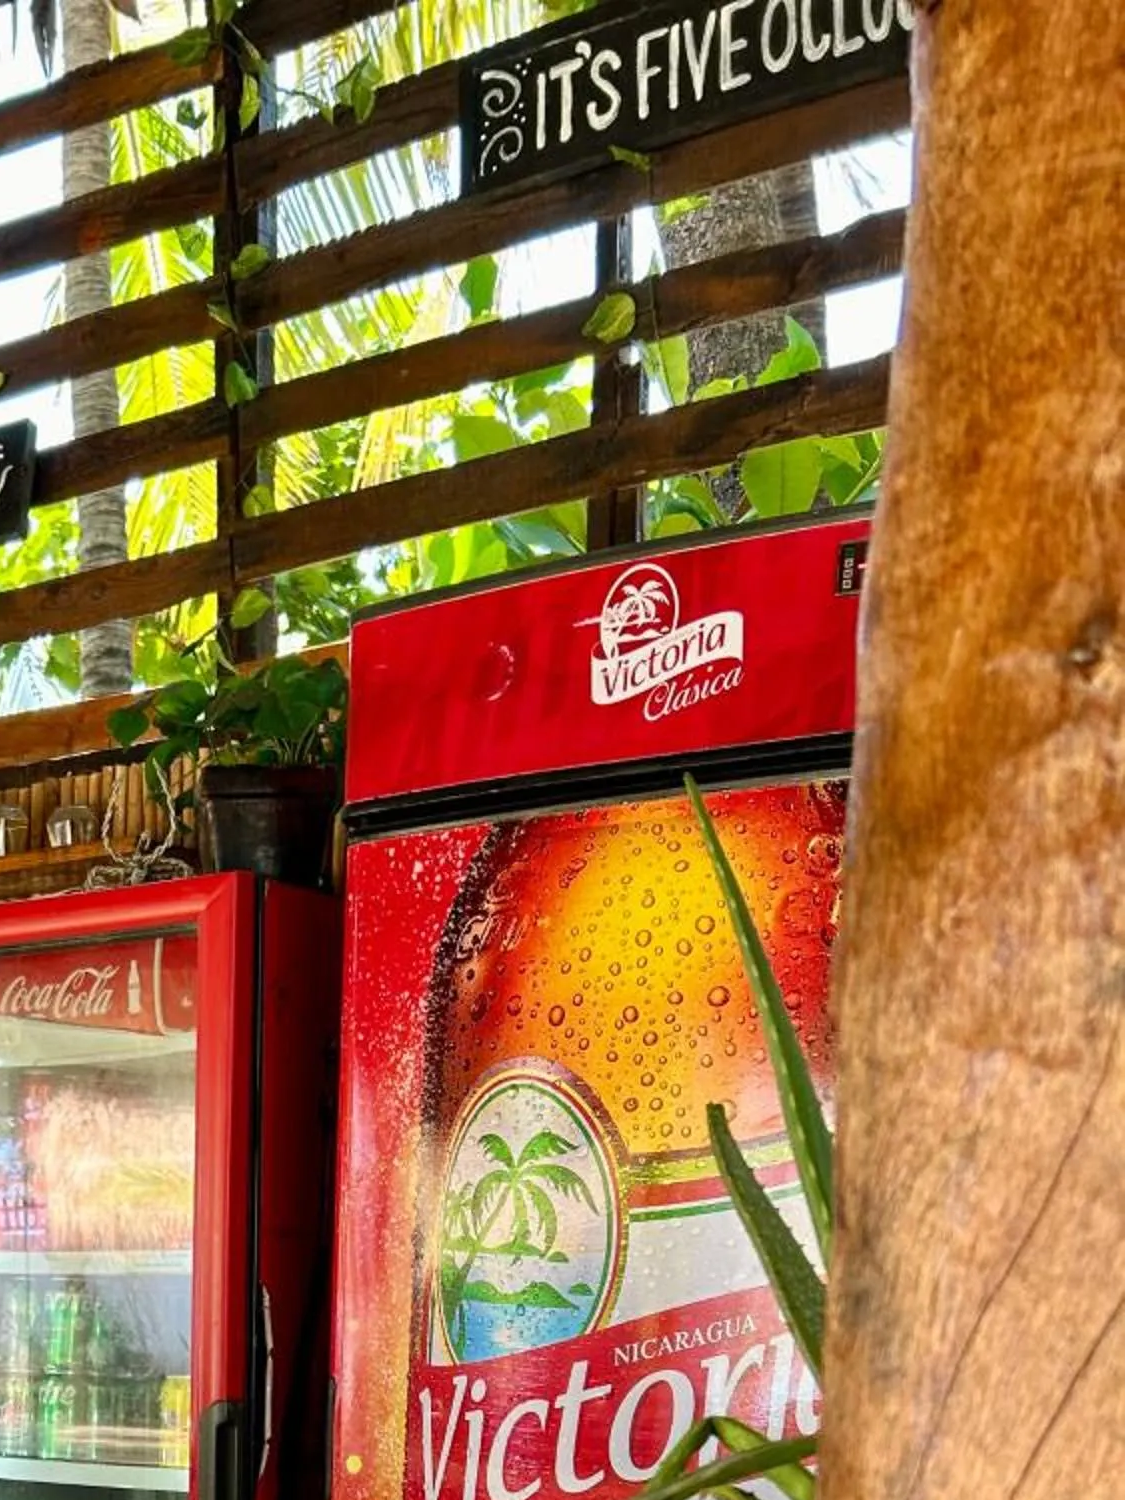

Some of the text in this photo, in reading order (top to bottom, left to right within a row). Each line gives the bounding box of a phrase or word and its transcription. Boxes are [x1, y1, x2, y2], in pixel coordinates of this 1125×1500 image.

[536, 39, 622, 151] IT'S
[637, 0, 753, 119] FIVE
[600, 621, 726, 698] Victoria
[643, 664, 745, 722] Clásica
[613, 1313, 758, 1366] NICARAGUA
